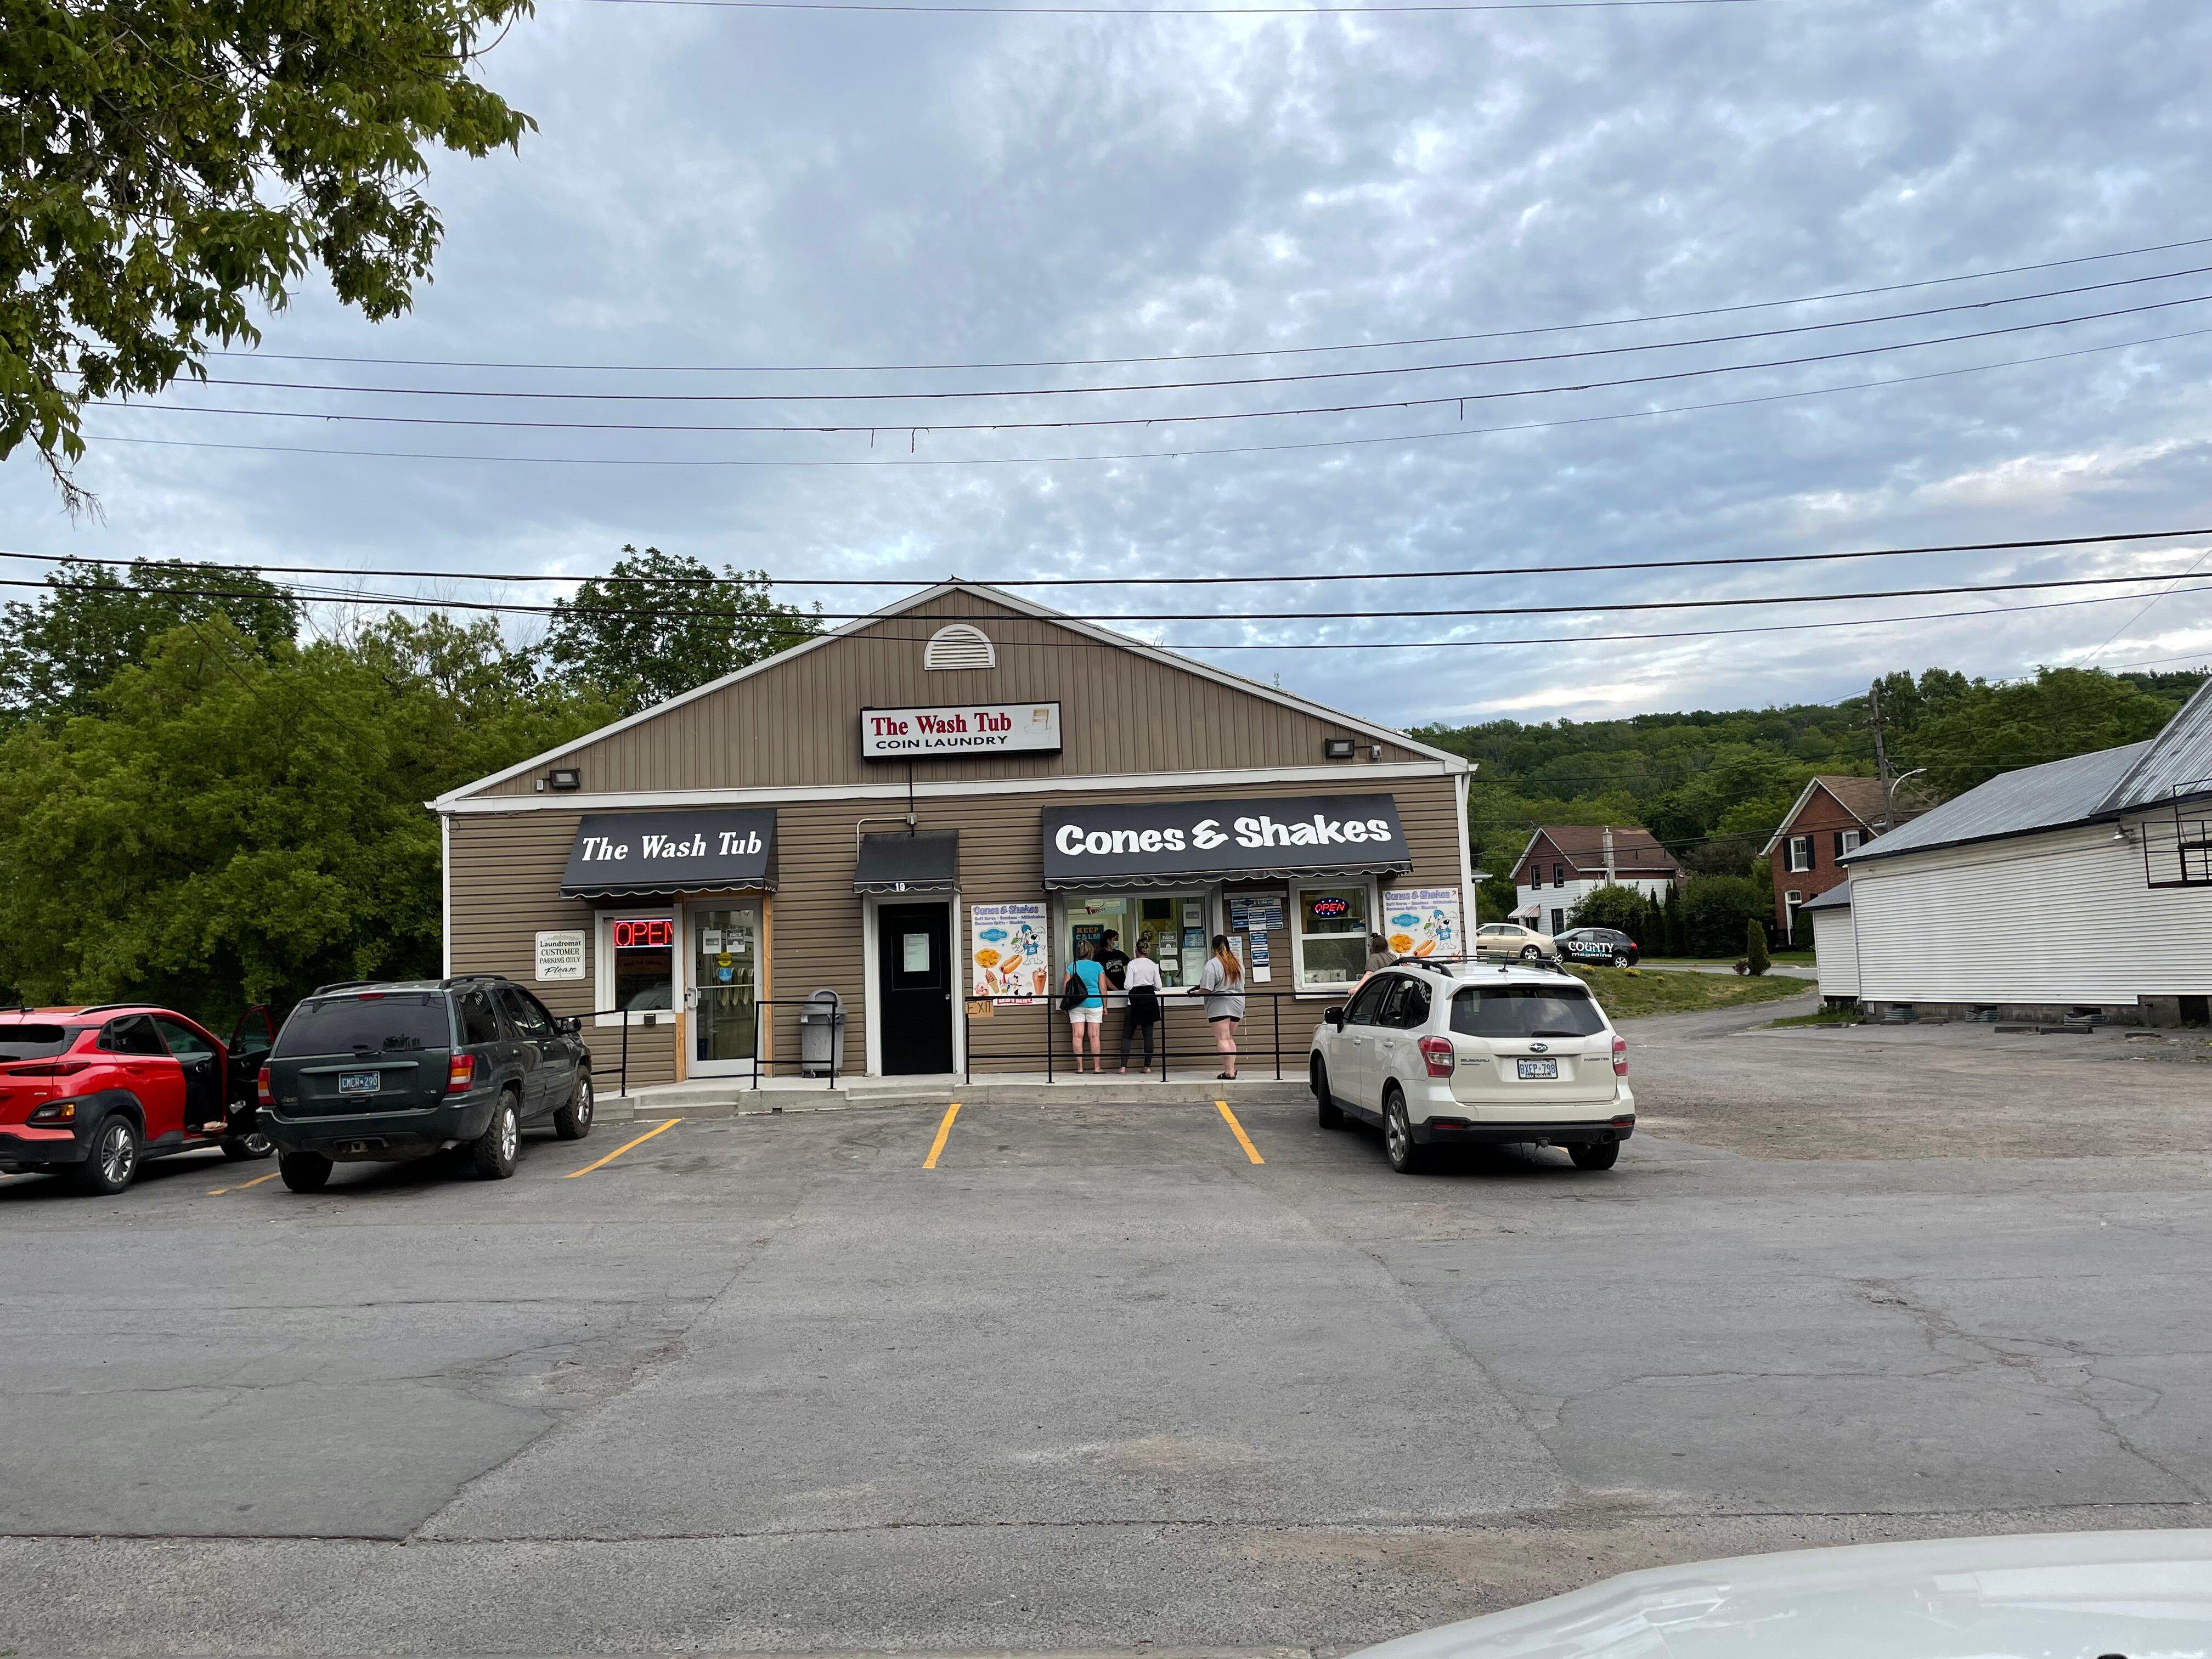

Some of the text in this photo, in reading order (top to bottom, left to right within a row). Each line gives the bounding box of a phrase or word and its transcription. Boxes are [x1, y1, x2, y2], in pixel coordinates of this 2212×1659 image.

[871, 713, 1012, 736] The Wash Tub
[876, 736, 1008, 749] COIN LAUNDRY
[1056, 814, 1392, 855] Cones & Shakes
[582, 831, 762, 861] The Wash Tub
[895, 883, 905, 891] 19
[1385, 890, 1450, 900] Cones & Shakes
[974, 905, 1039, 915] Cones & Shakes
[1314, 903, 1345, 911] OPEN
[541, 948, 580, 956] CUSTOMER
[1568, 941, 1614, 953] COUNTY
[544, 966, 577, 976] Please
[967, 1001, 992, 1014] EXIT
[1542, 1064, 1556, 1074] 798
[342, 1076, 377, 1088] CMCR 290
